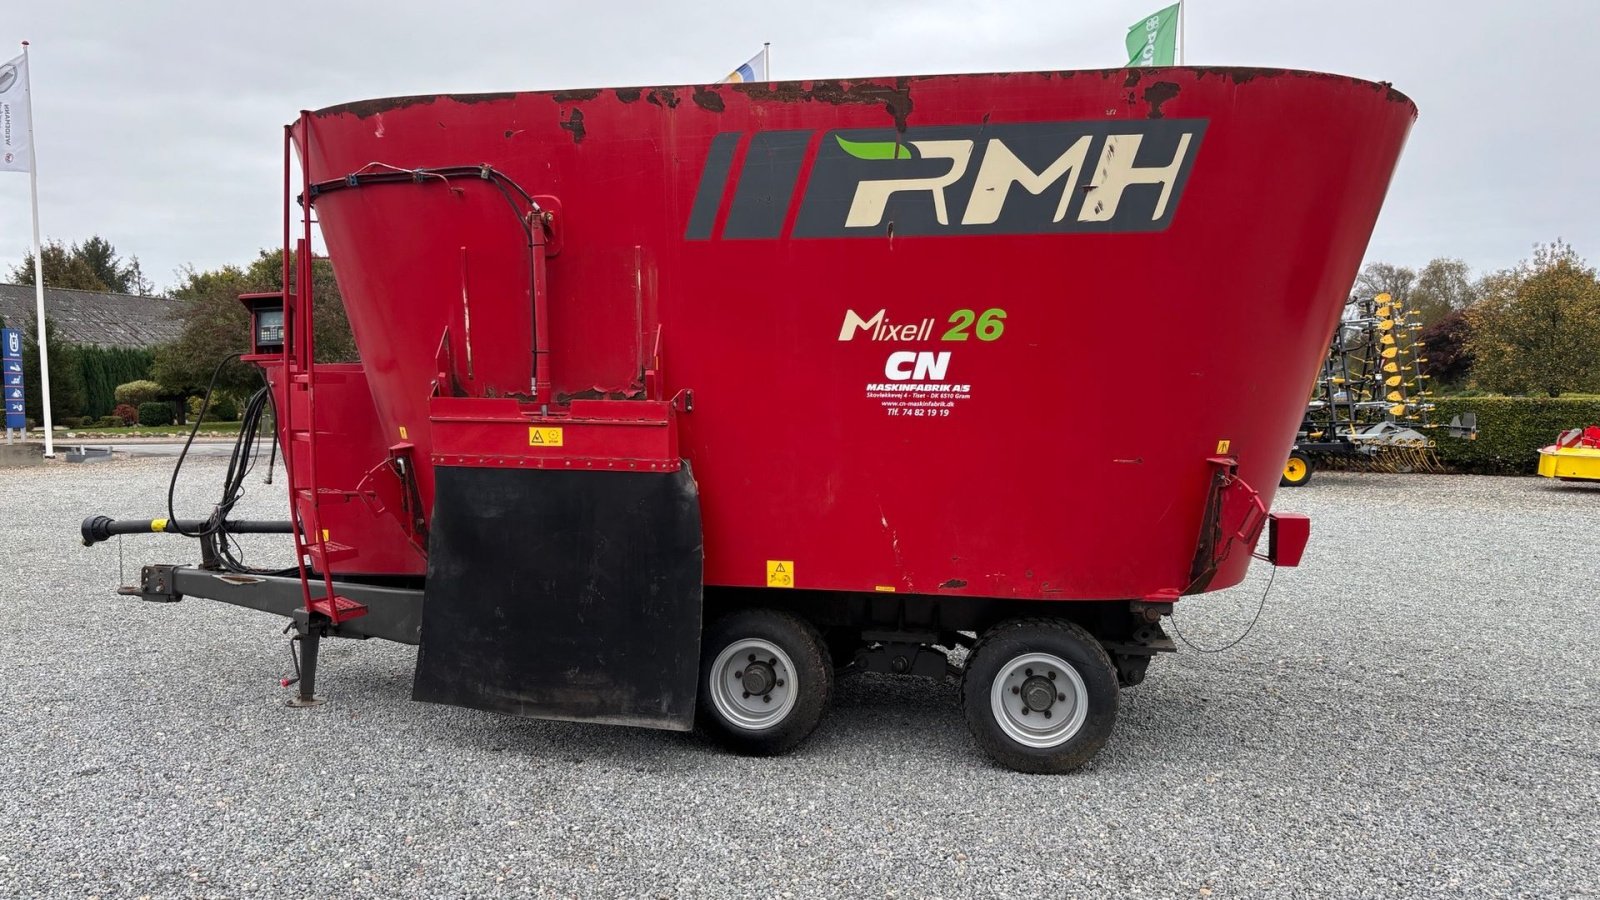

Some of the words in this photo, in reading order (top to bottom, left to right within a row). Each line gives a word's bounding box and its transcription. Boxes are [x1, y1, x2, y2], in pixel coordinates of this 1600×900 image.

[841, 133, 1193, 228] RMH
[838, 309, 935, 341] Mixell
[941, 308, 1008, 342] 26
[884, 351, 952, 381] CN
[866, 383, 951, 392] MASKINFABRIK
[902, 408, 912, 416] 74
[914, 408, 925, 416] 82
[927, 409, 937, 417] 19
[939, 409, 950, 417] 19
